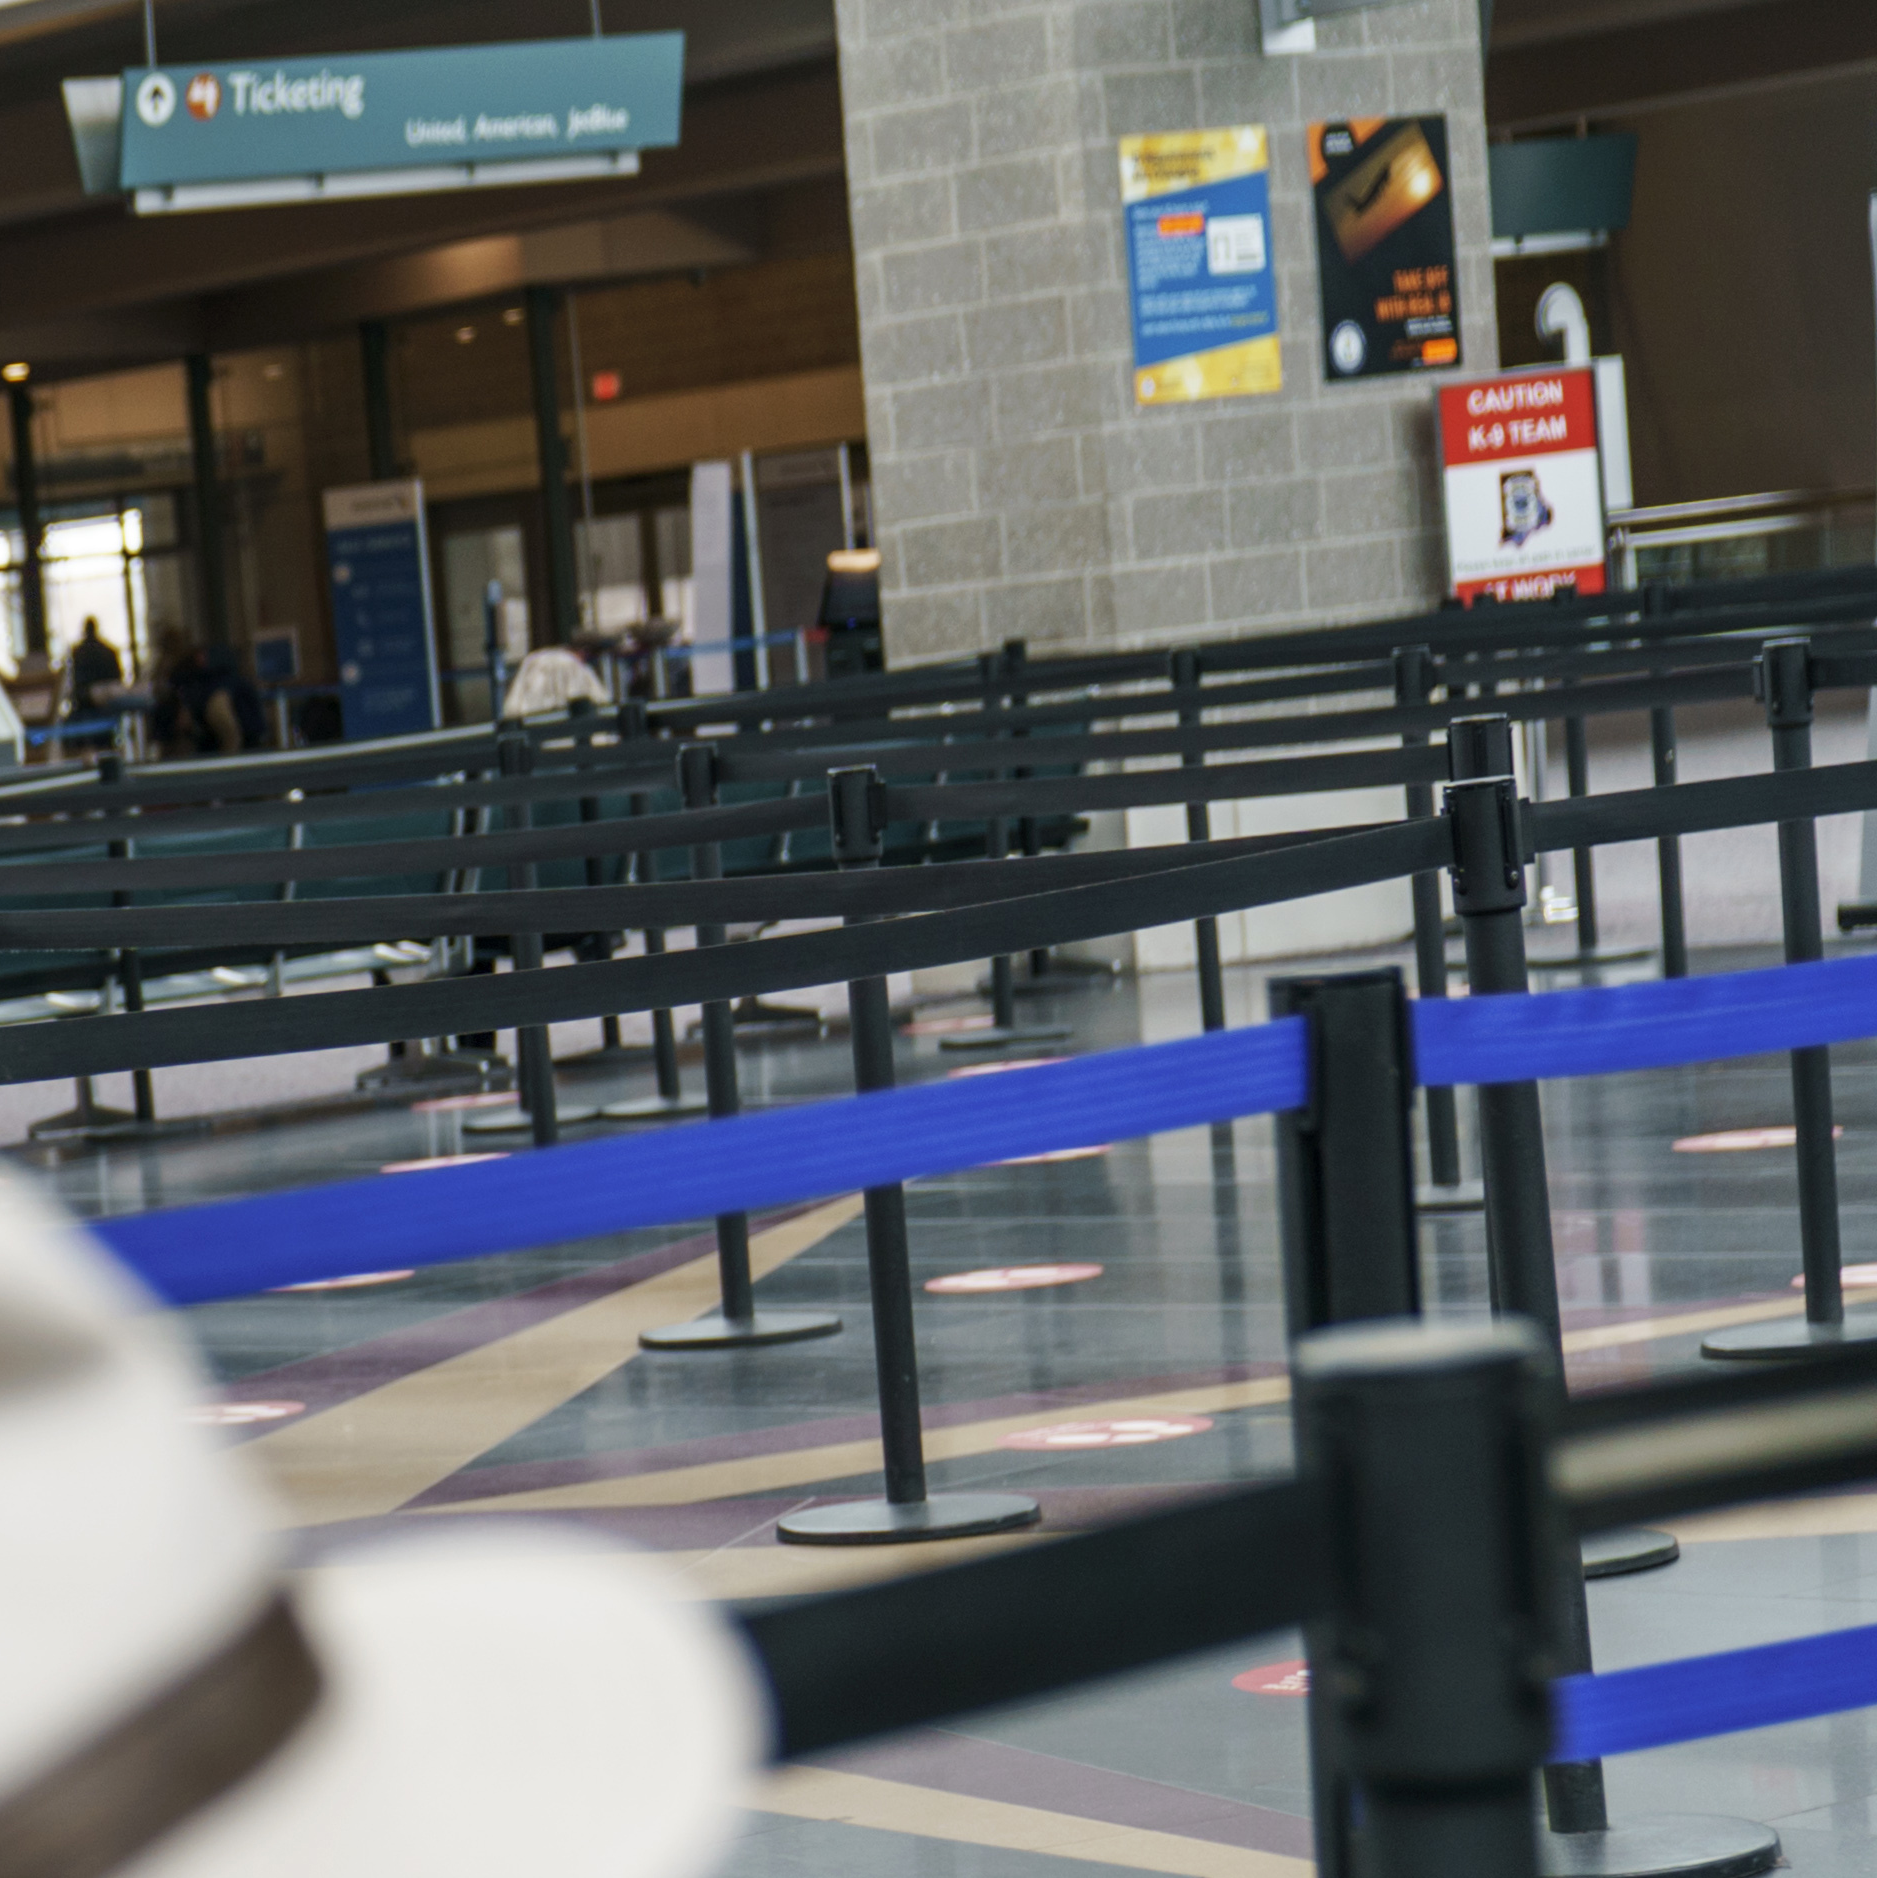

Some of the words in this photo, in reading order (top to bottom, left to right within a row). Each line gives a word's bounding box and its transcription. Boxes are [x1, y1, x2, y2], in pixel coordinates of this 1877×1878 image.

[228, 69, 364, 119] Ticketing
[1467, 380, 1563, 416] CAUTION
[1468, 422, 1505, 452] K-9
[1508, 414, 1567, 445] TEAM
